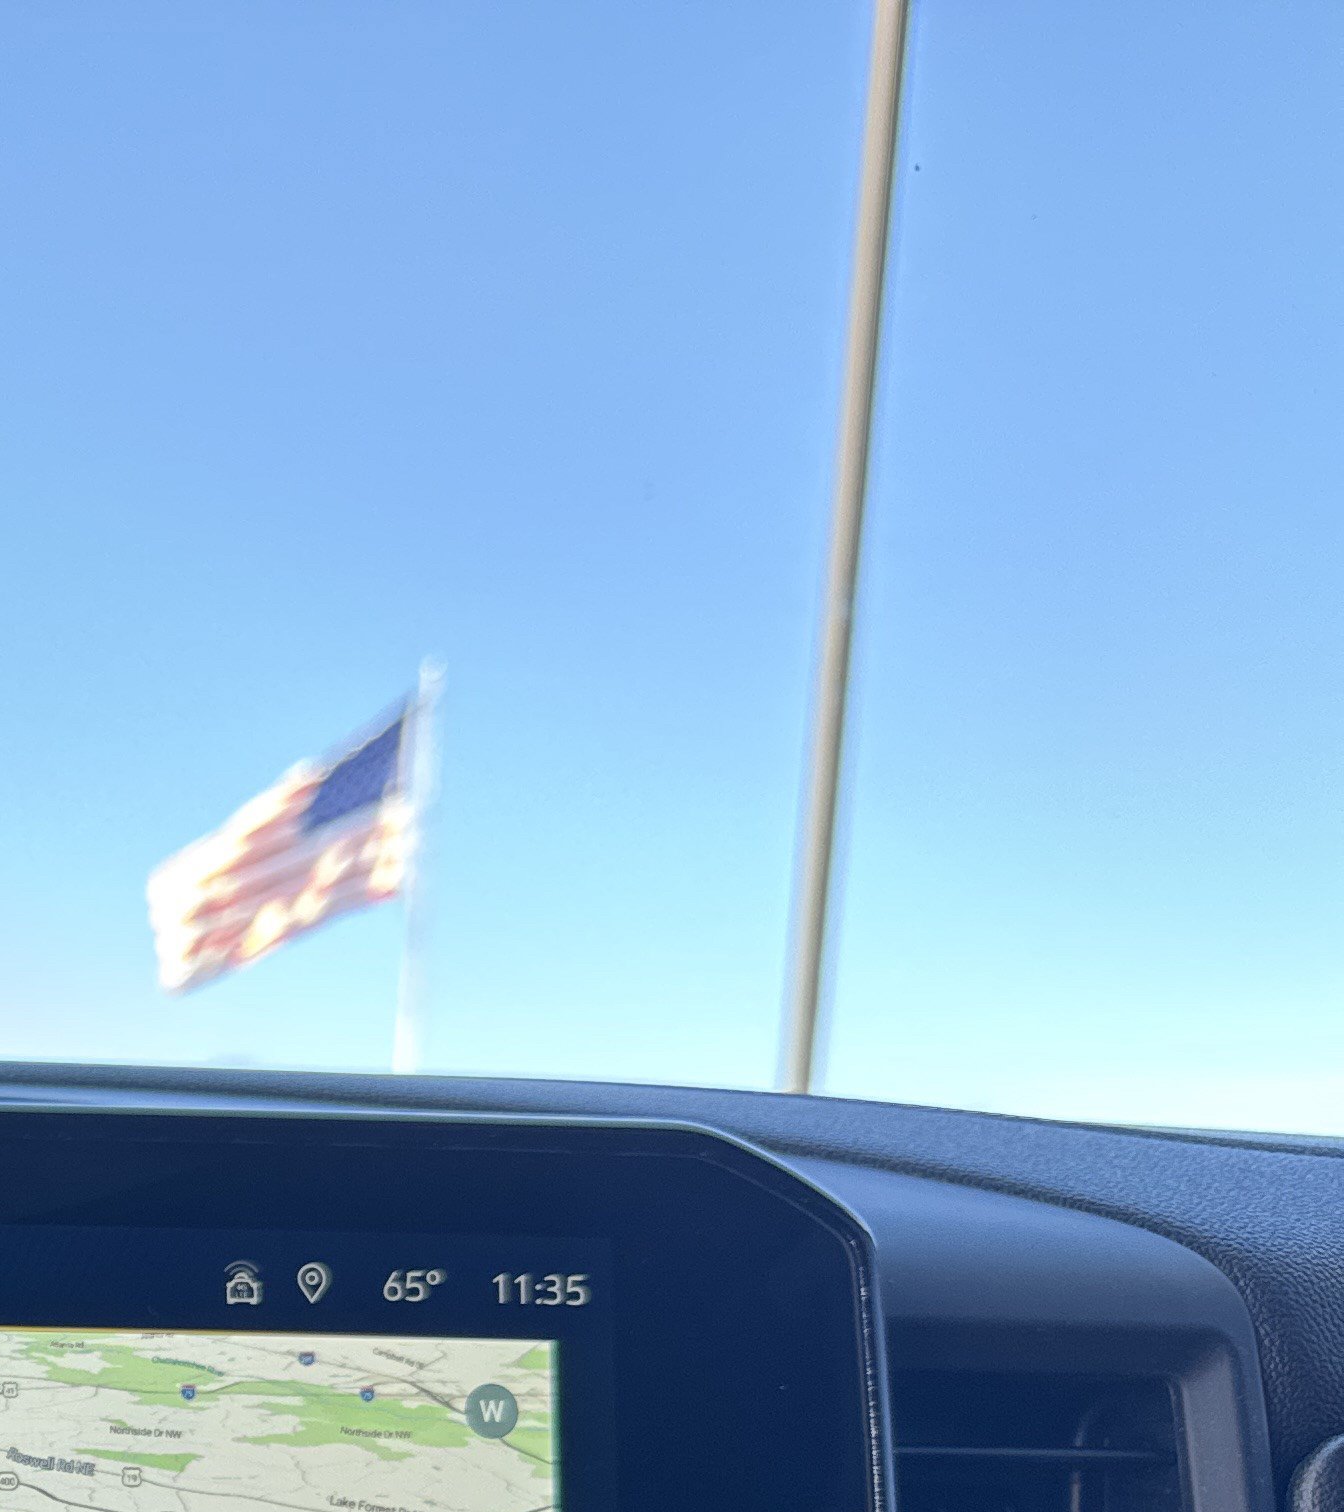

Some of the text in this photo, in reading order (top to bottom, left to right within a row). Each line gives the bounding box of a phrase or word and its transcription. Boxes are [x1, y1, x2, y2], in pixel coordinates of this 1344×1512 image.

[382, 1269, 447, 1303] 65°
[492, 1272, 591, 1306] 11:35
[479, 1399, 504, 1423] W
[110, 1426, 182, 1438] Northside Dr NW
[340, 1426, 382, 1439] Northside
[6, 1447, 96, 1477] Roswell Rd NE
[330, 1495, 355, 1509] Lake
